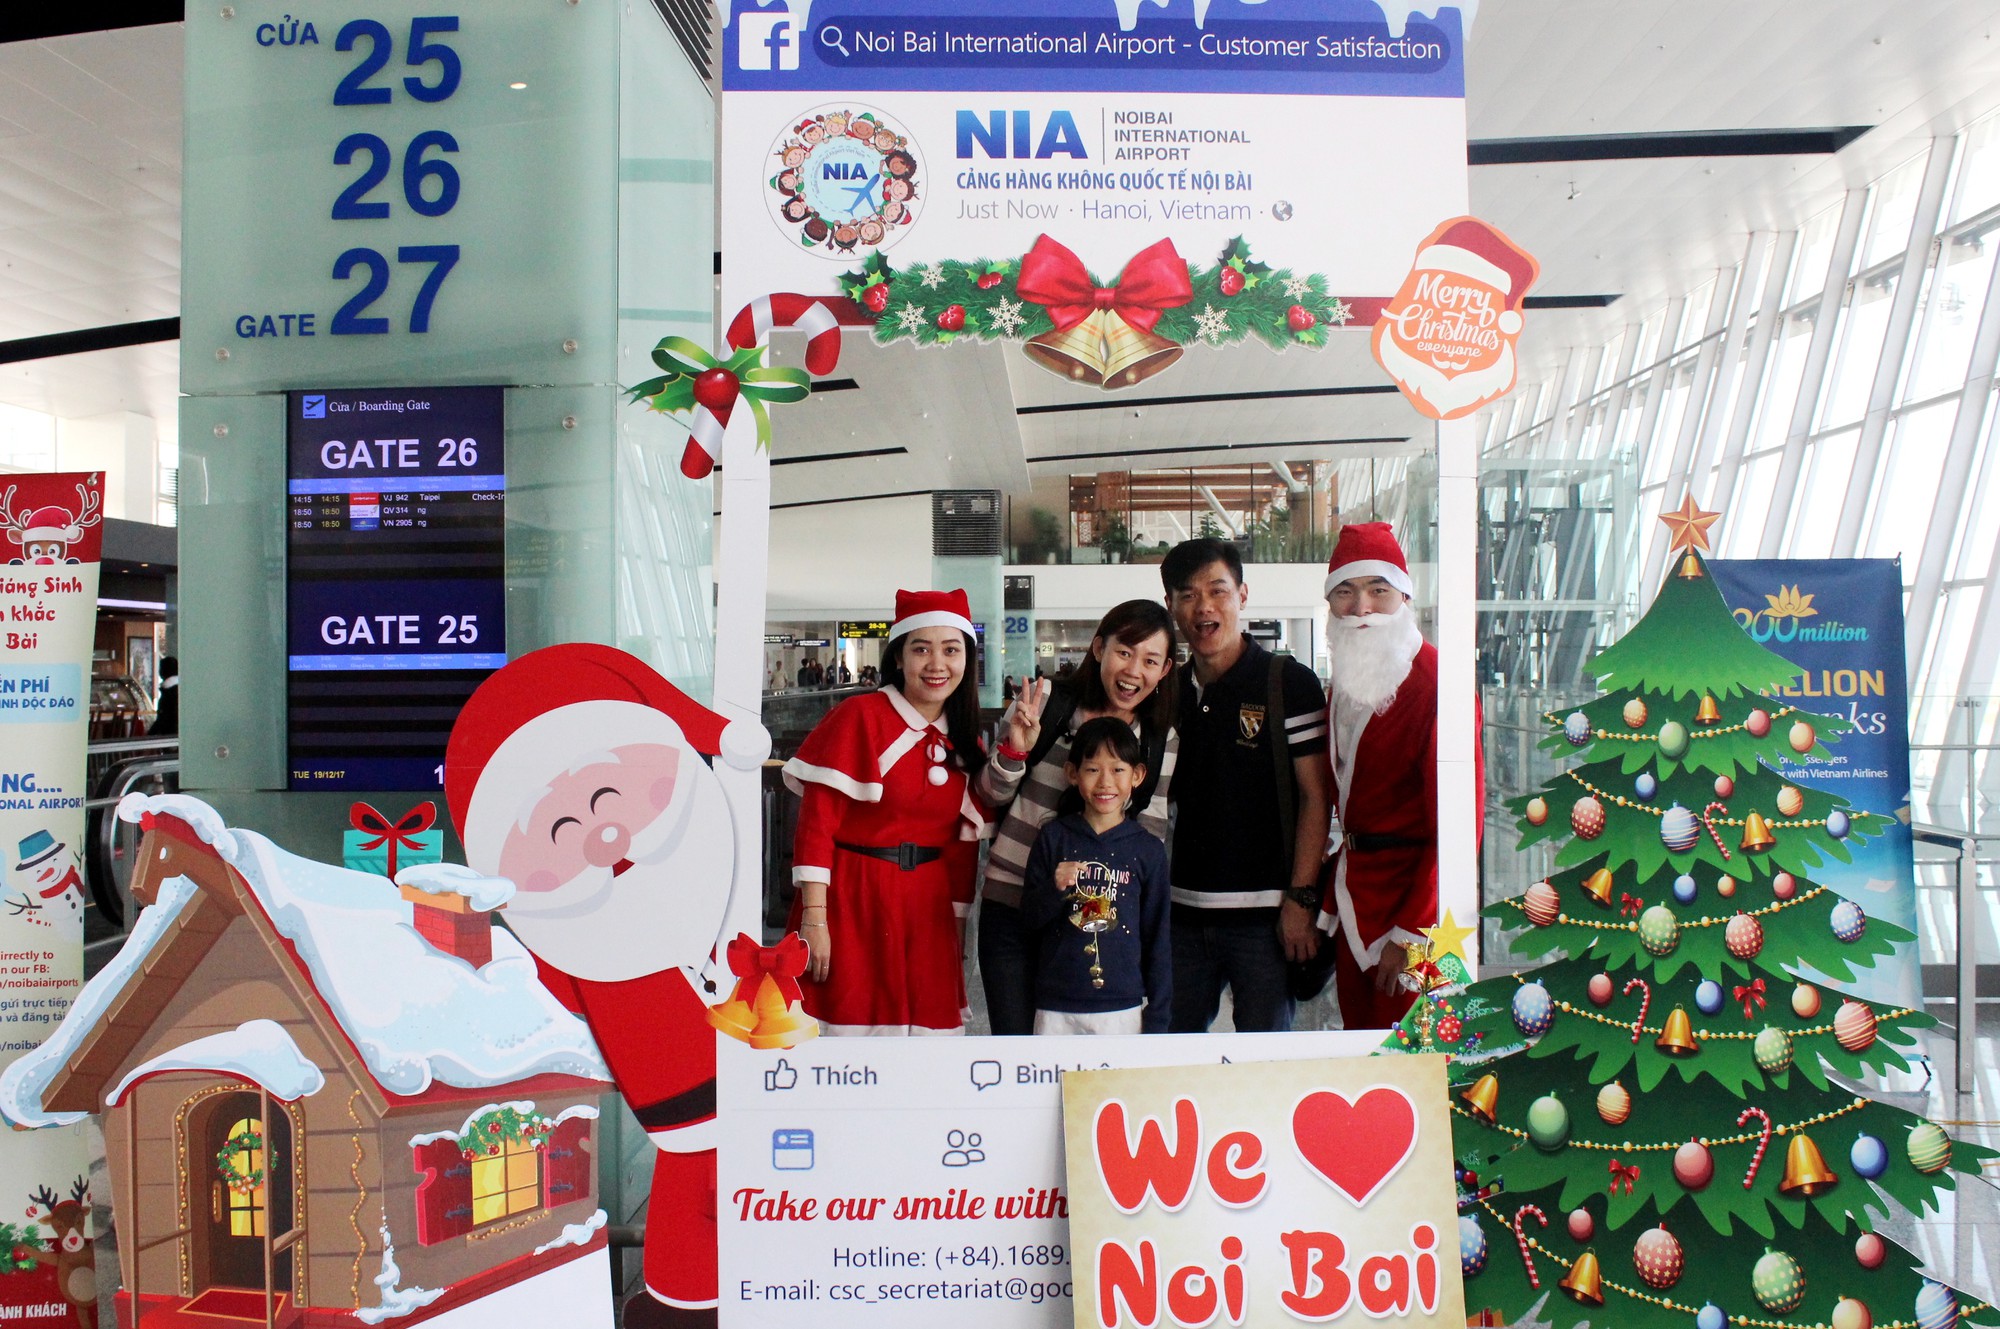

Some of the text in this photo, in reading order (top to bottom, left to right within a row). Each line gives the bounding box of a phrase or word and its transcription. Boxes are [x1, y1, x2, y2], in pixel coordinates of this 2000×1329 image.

[855, 31, 895, 52] Noi
[904, 31, 937, 53] Bai
[945, 31, 1087, 54] International
[1095, 31, 1176, 60] Airport
[1199, 33, 1310, 57] Customer
[1316, 35, 1441, 59] Satisfaction
[256, 15, 462, 106] CỬA 25
[1114, 111, 1172, 125] NOIBAI
[956, 110, 1088, 159] NIA
[1114, 129, 1251, 143] INTERNATIONAL
[1115, 147, 1191, 161] AIRPORT
[331, 130, 461, 221] 26
[823, 163, 868, 180] NIA
[956, 167, 1252, 195] CẢNG HÀNG KHÔNG QUỐC TẾ NỘI BÀI
[956, 199, 1251, 222] Just Now Hanoi, Vietnam
[235, 244, 461, 339] GATE 27
[1413, 272, 1497, 328] Merry
[1381, 304, 1502, 351] Christmas
[1416, 340, 1483, 358] everyone
[359, 400, 405, 413] Boarding
[406, 399, 431, 411] Gate
[320, 437, 478, 469] GATE 26
[383, 494, 393, 502] VJ
[420, 493, 441, 502] Taipei
[44, 576, 83, 593] Sinh
[11, 600, 56, 621] khắc
[320, 615, 478, 645] GATE 25
[1004, 616, 1029, 634] 28
[1798, 621, 1870, 642] million
[6, 632, 38, 650] Bài
[1042, 644, 1052, 652] 29
[21, 676, 50, 693] PHÍ
[49, 696, 75, 708] ĐÁO
[293, 771, 345, 779] TUE 19/12/17
[1788, 768, 1809, 779] with
[1810, 768, 1851, 779] Vietnam
[1852, 768, 1889, 779] Airlines
[38, 797, 85, 809] AIRPORT
[1093, 867, 1103, 880] IT
[43, 951, 54, 960] to
[11, 966, 30, 974] our
[33, 964, 50, 974] FB:
[0, 977, 79, 990] /noibaiairports
[23, 998, 45, 1009] trực
[48, 996, 68, 1009] tiếp
[6, 1012, 19, 1022] và
[811, 1064, 1066, 1086] Thích Bình
[1096, 1098, 1266, 1210] We
[733, 1186, 1069, 1222] Take our smile with
[832, 1246, 926, 1268] Hotline:
[1098, 1224, 1437, 1328] Noi Bai
[740, 1279, 820, 1300] E-mail:
[26, 1301, 67, 1318] KHÁCH
